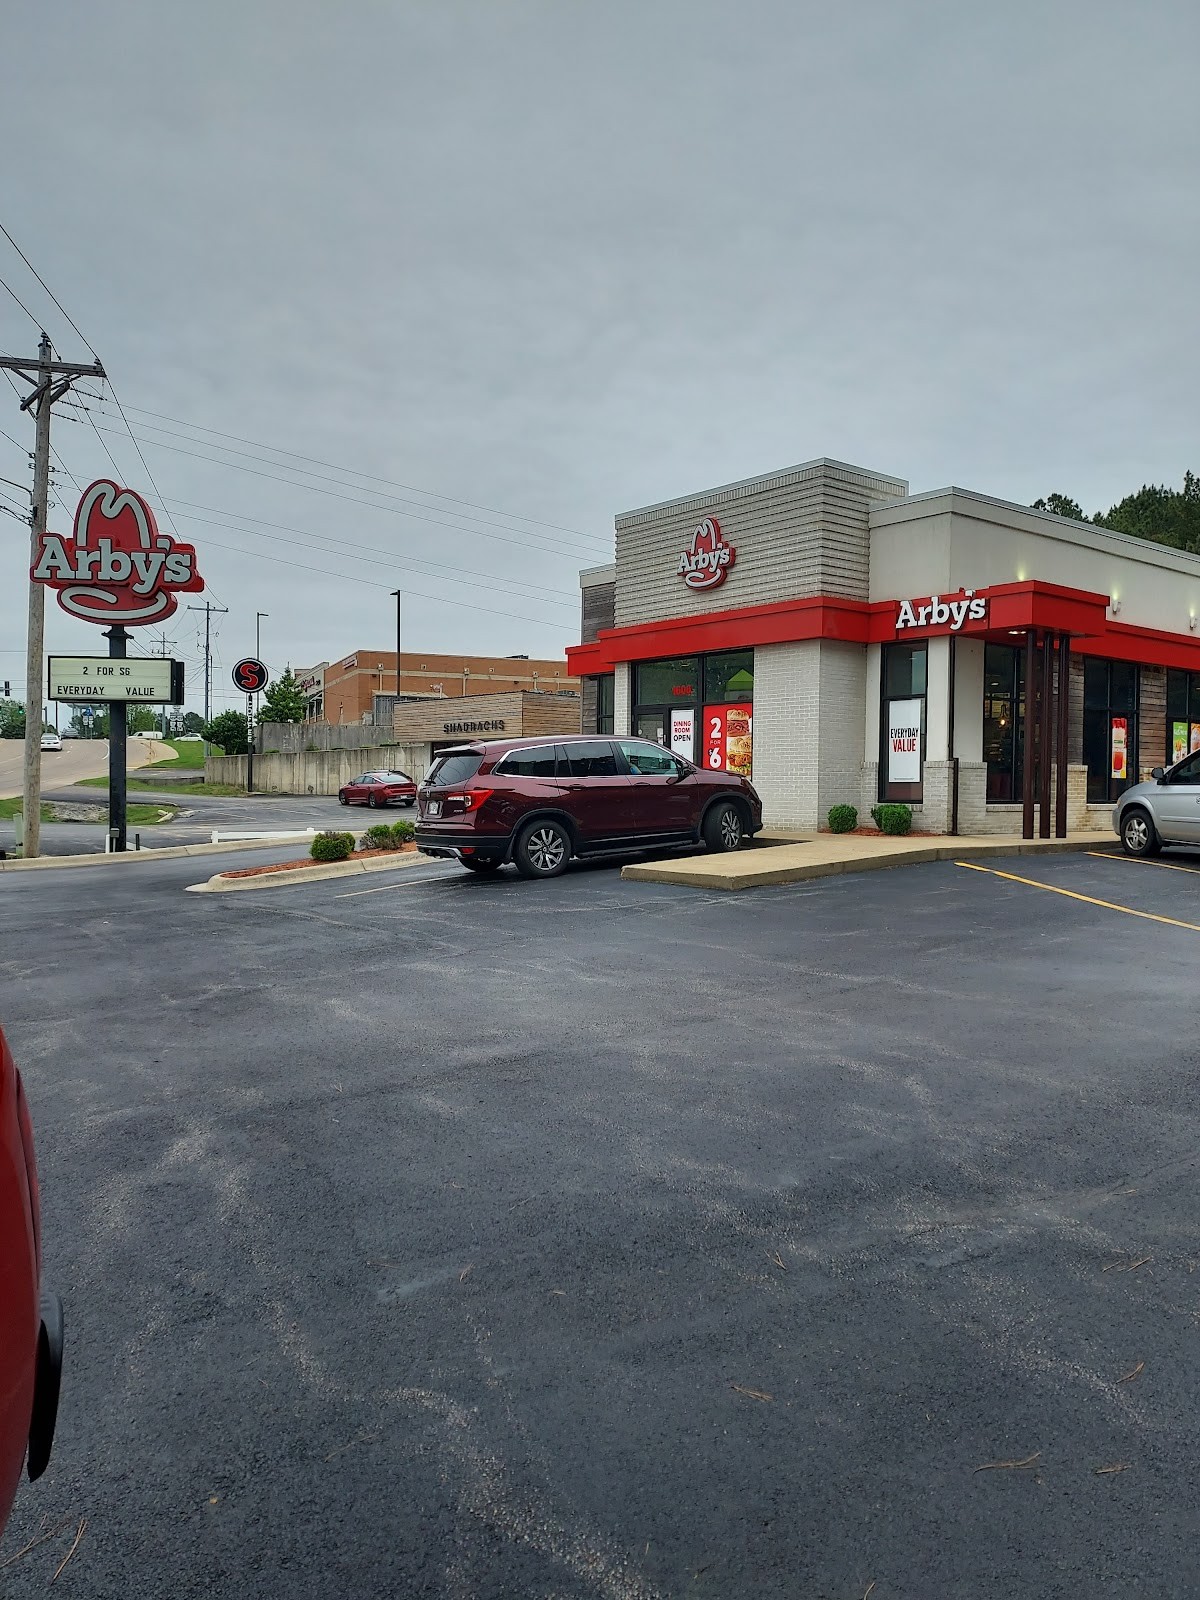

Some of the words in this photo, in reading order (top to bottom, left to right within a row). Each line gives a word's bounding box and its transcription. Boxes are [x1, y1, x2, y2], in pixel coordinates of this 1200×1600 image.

[33, 536, 192, 594] Arby's
[677, 542, 730, 573] Arby's
[895, 589, 986, 630] Arby's
[82, 666, 89, 676] 2
[96, 667, 114, 676] FOR
[240, 663, 259, 688] S
[57, 685, 105, 695] EVERYDAY
[125, 687, 155, 696] VALUE
[710, 717, 722, 739] 2
[890, 727, 919, 739] EVERYDAY
[892, 738, 917, 752] VALUE
